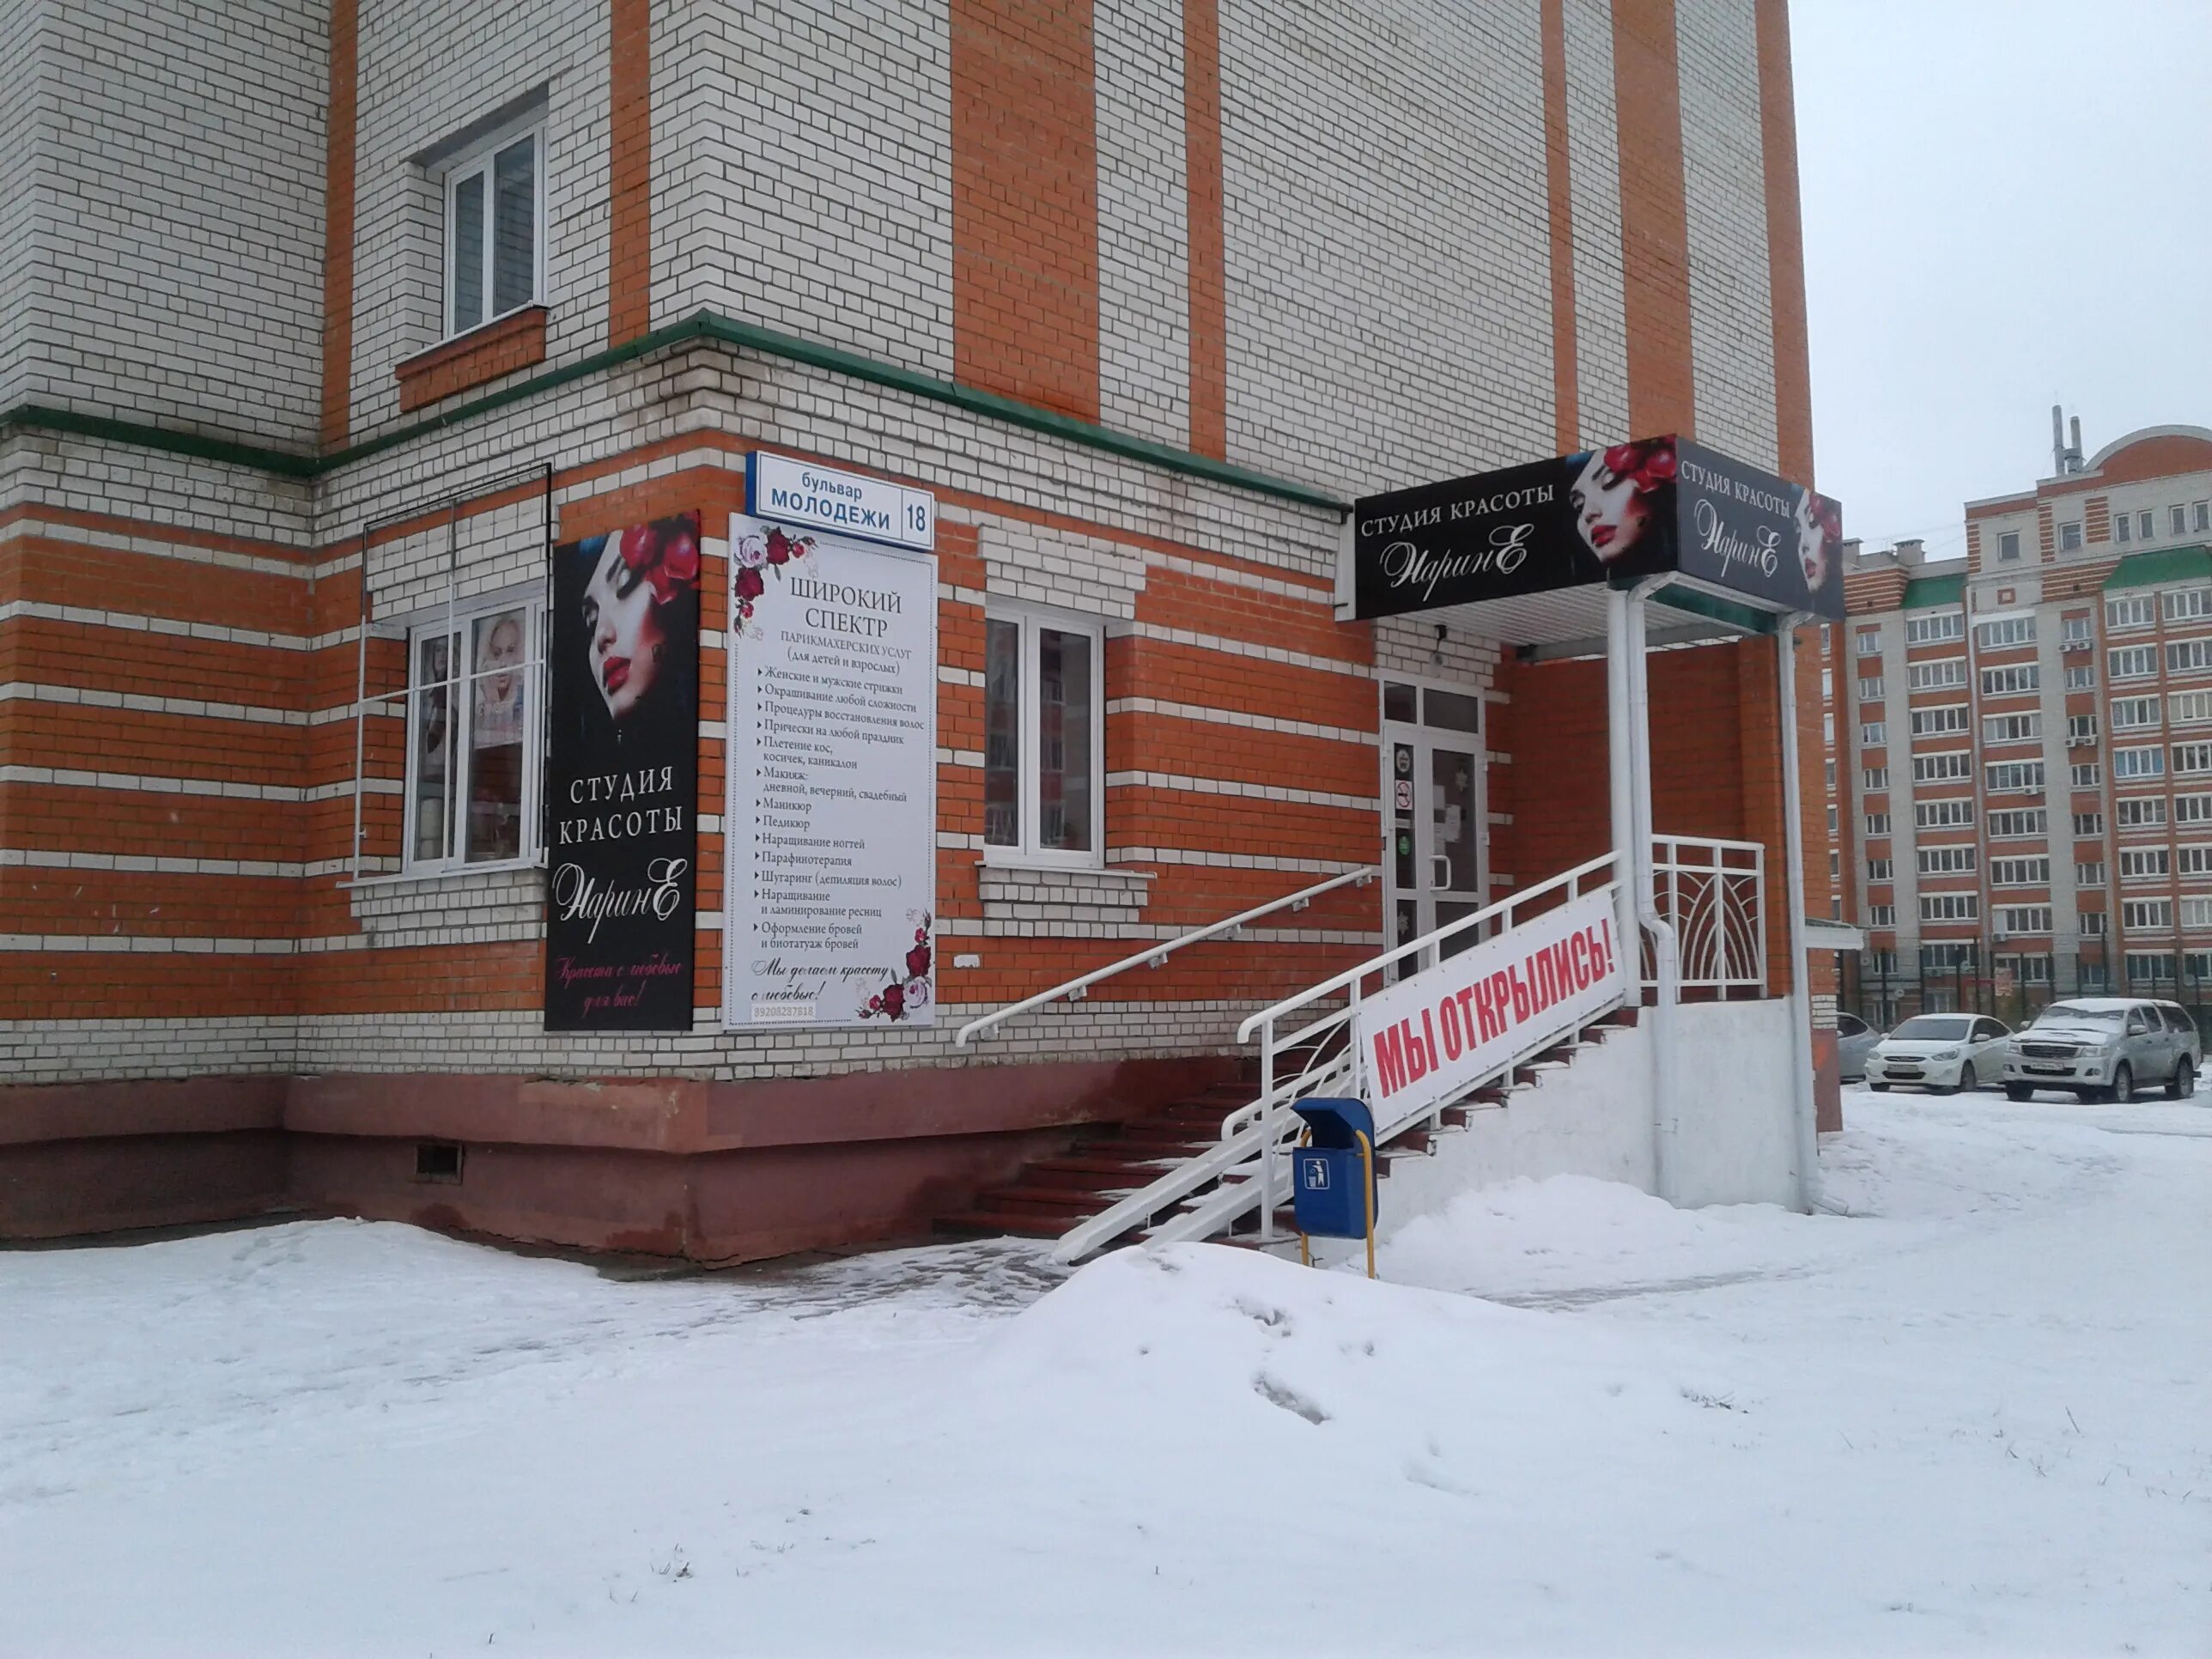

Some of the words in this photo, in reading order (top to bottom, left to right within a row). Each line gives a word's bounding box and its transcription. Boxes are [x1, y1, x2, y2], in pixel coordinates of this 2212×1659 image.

[801, 472, 862, 501] бульвар
[1680, 460, 1730, 496] СТУДИЯ
[1735, 481, 1790, 519] КРАСОТЫ
[771, 489, 890, 530] МОЛОДЕЖИ
[907, 503, 926, 532] 18
[1361, 507, 1442, 537] СТУДИЯ
[1449, 484, 1555, 520] КРАСОТЫ
[790, 576, 902, 614] ШИРОКИЙ
[805, 608, 888, 638] СПЕКТР
[781, 630, 879, 656] ПАРИКМАХЕРСКИХ
[880, 645, 912, 660] УСЛУГ
[787, 646, 810, 663] (для
[812, 651, 841, 666] детей
[842, 657, 849, 666] и
[851, 658, 900, 677] взрослых)
[764, 665, 811, 683] Женские
[812, 673, 819, 684] и
[821, 677, 862, 690] мужские
[863, 683, 903, 695] стрижки
[764, 683, 834, 702] Окрашивание
[836, 692, 866, 708] любой
[867, 700, 917, 714] сложности
[764, 700, 823, 721] Процедуры
[824, 710, 897, 727] восстановления
[899, 718, 925, 730] волос
[763, 735, 812, 751] Плетение
[814, 743, 833, 755] кос,
[764, 718, 814, 735] Прически
[816, 726, 827, 737] на
[829, 726, 860, 740] любой
[861, 731, 904, 745] праздник
[763, 752, 805, 766] косичек,
[807, 757, 858, 770] каникалон
[763, 765, 809, 781] Макияж:
[570, 766, 673, 804] СТУДИЯ
[763, 781, 808, 796] дневной,
[809, 786, 857, 800] вечерний,
[859, 788, 908, 803] свадебный
[763, 797, 812, 815] Маникюр
[559, 806, 683, 845] КРАСОТЫ
[763, 815, 811, 832] Педикюр
[762, 832, 831, 850] Наращивание
[833, 837, 866, 850] ногтей
[762, 851, 853, 868] Парафинотерапия
[761, 870, 813, 887] Шугаринг
[815, 872, 870, 887] (депиляция
[872, 874, 902, 890] волос)
[761, 888, 831, 903] Наращивание
[761, 905, 768, 915] и
[769, 905, 847, 919] ламинирование
[848, 908, 882, 919] ресниц
[761, 921, 826, 938] Оформление
[828, 922, 862, 938] бровей
[761, 939, 768, 948] и
[770, 937, 823, 951] биотатуаж
[824, 937, 859, 951] бровей
[556, 956, 613, 989] Красота
[751, 957, 786, 976] Мы
[788, 966, 838, 983] делаем
[840, 966, 889, 983] красоту
[751, 992, 758, 1000] с
[1373, 1007, 1439, 1099] МЫ
[1439, 917, 1615, 1062] ОТКРЫЛИСЬ!
